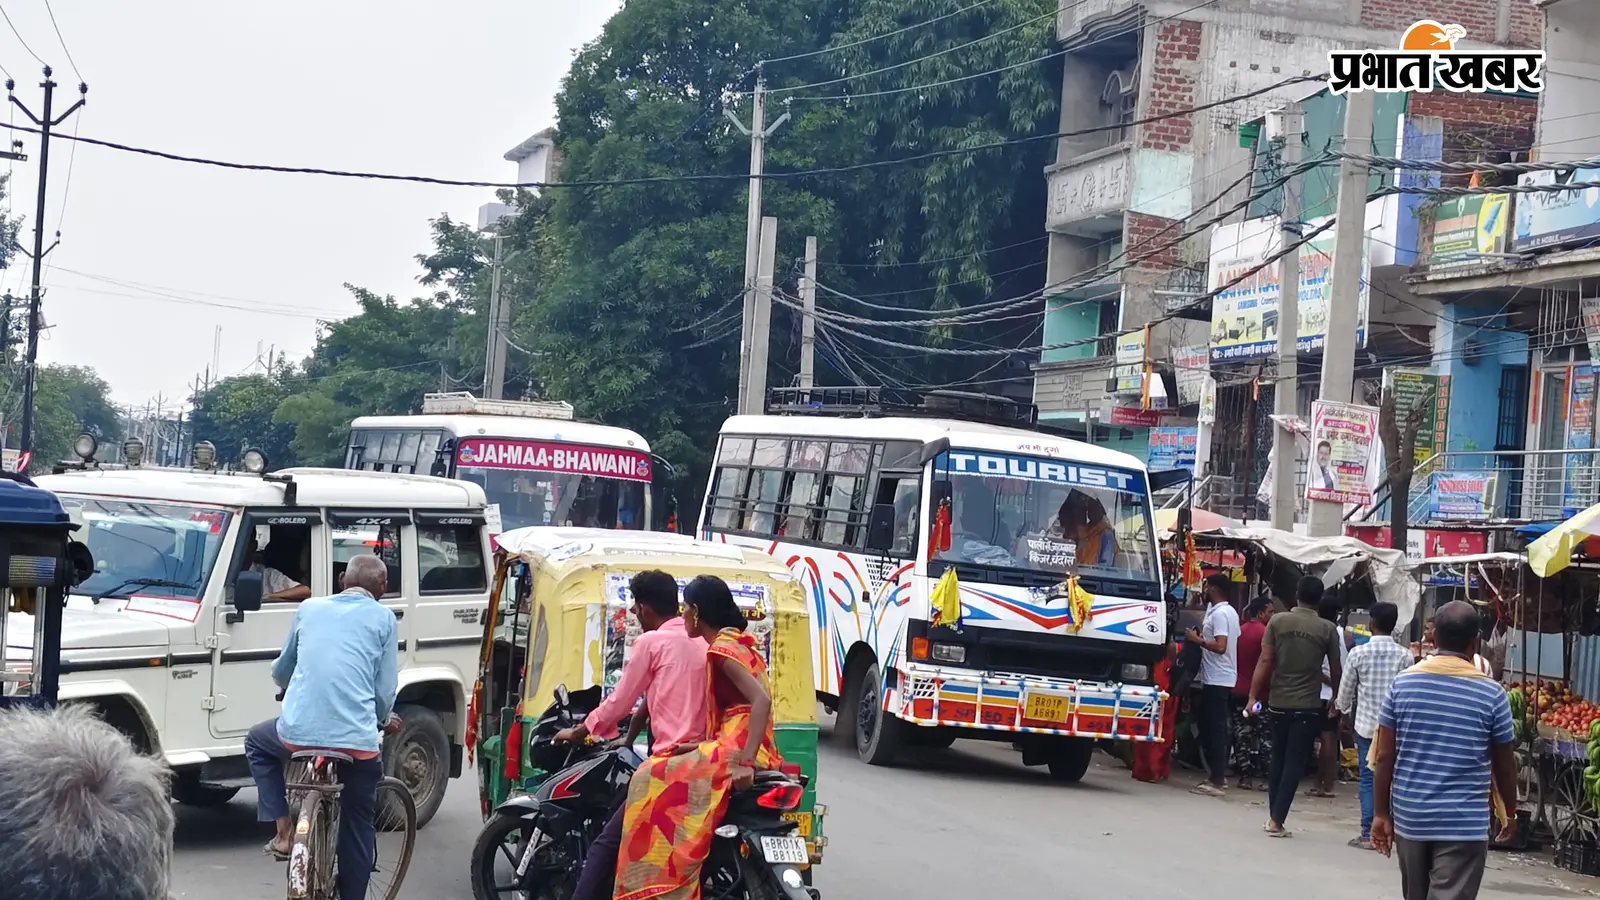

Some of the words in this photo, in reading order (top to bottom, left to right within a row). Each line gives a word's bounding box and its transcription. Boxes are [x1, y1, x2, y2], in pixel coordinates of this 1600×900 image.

[474, 443, 504, 463] JAI
[506, 445, 549, 467] MAA
[553, 449, 637, 476] BHAWANI
[950, 453, 1134, 489] TOURIST
[279, 517, 307, 525] BOLERO
[448, 517, 473, 525] BOLERO
[1035, 696, 1062, 709] BR01P
[770, 838, 800, 850] BR01K
[772, 850, 803, 861] B8119
